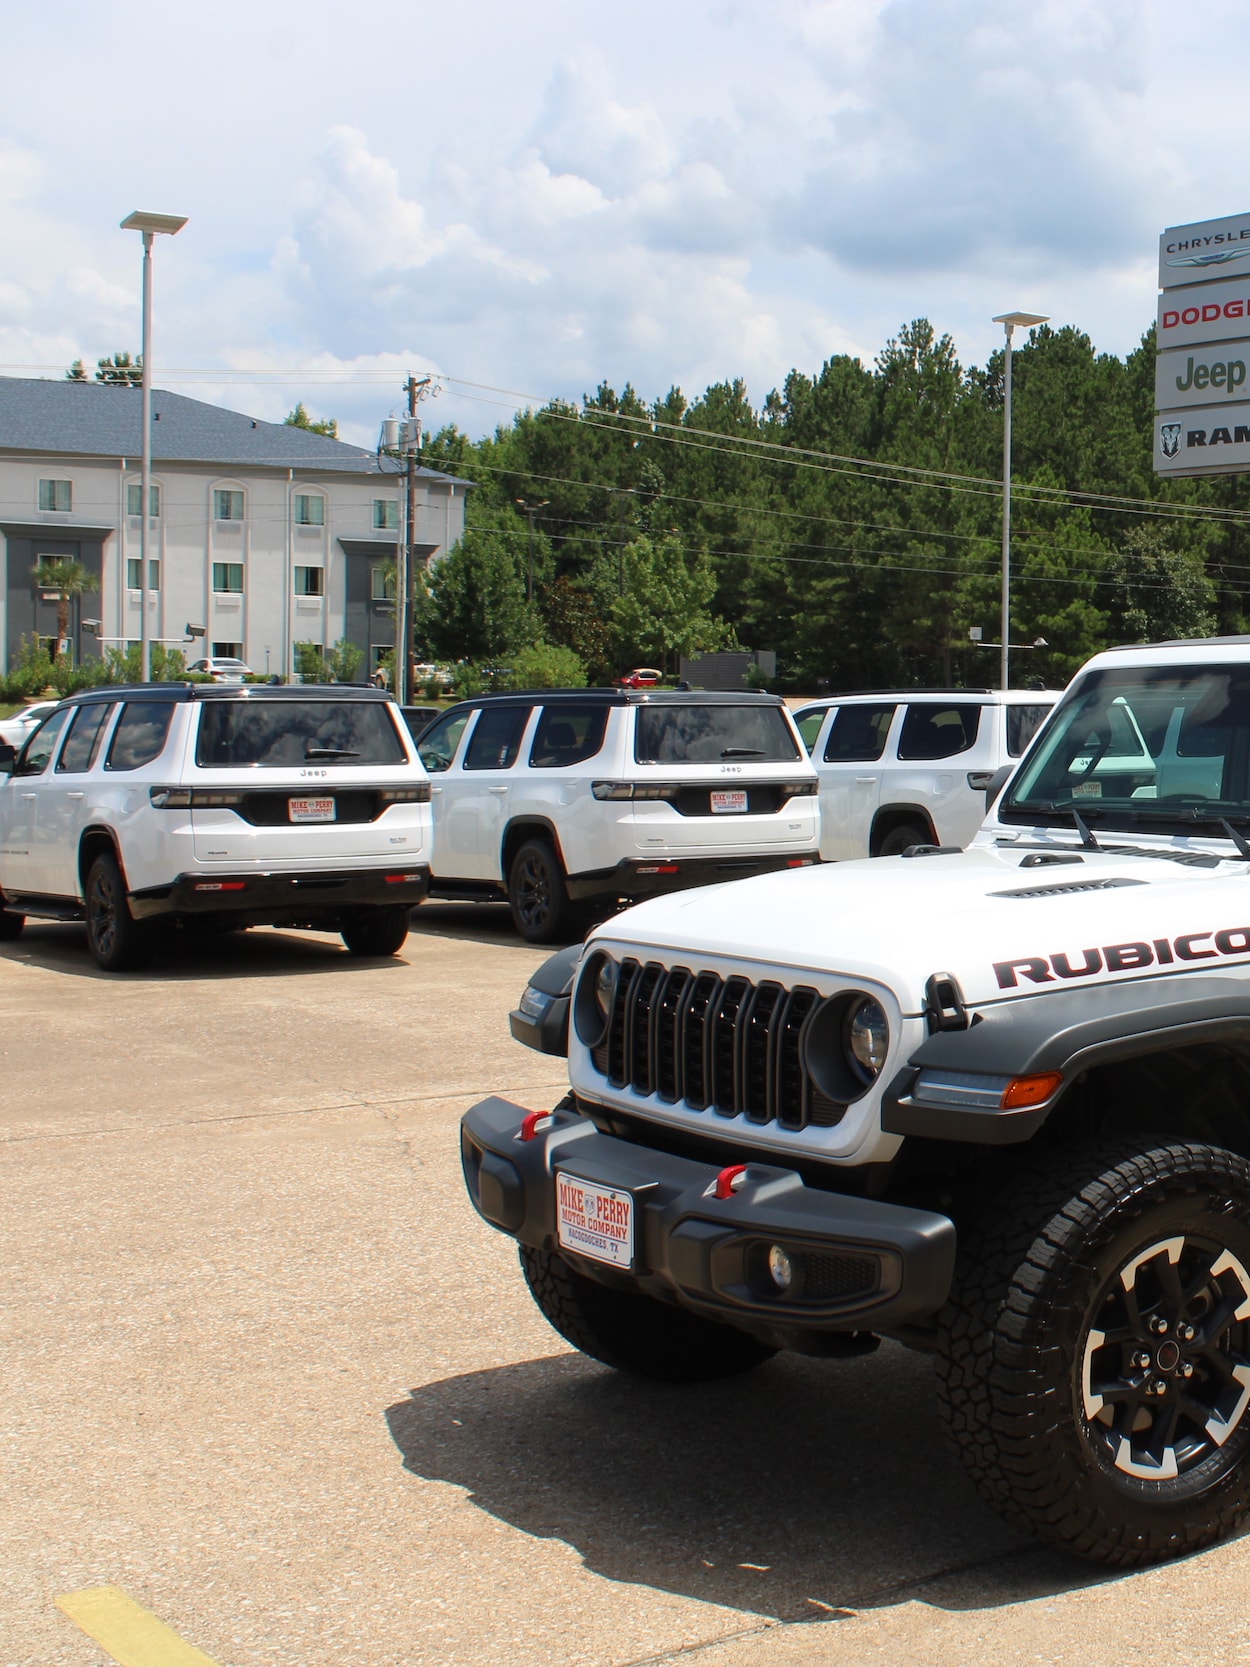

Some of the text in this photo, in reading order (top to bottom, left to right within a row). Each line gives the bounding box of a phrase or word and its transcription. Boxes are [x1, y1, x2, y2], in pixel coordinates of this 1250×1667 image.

[1176, 357, 1246, 393] Jeep
[300, 769, 327, 777] Jeep
[315, 800, 333, 808] PERRY
[560, 1183, 629, 1227] MIKE PERRY
[562, 1207, 627, 1240] MOTOR COMPANY
[610, 1242, 619, 1253] TX
